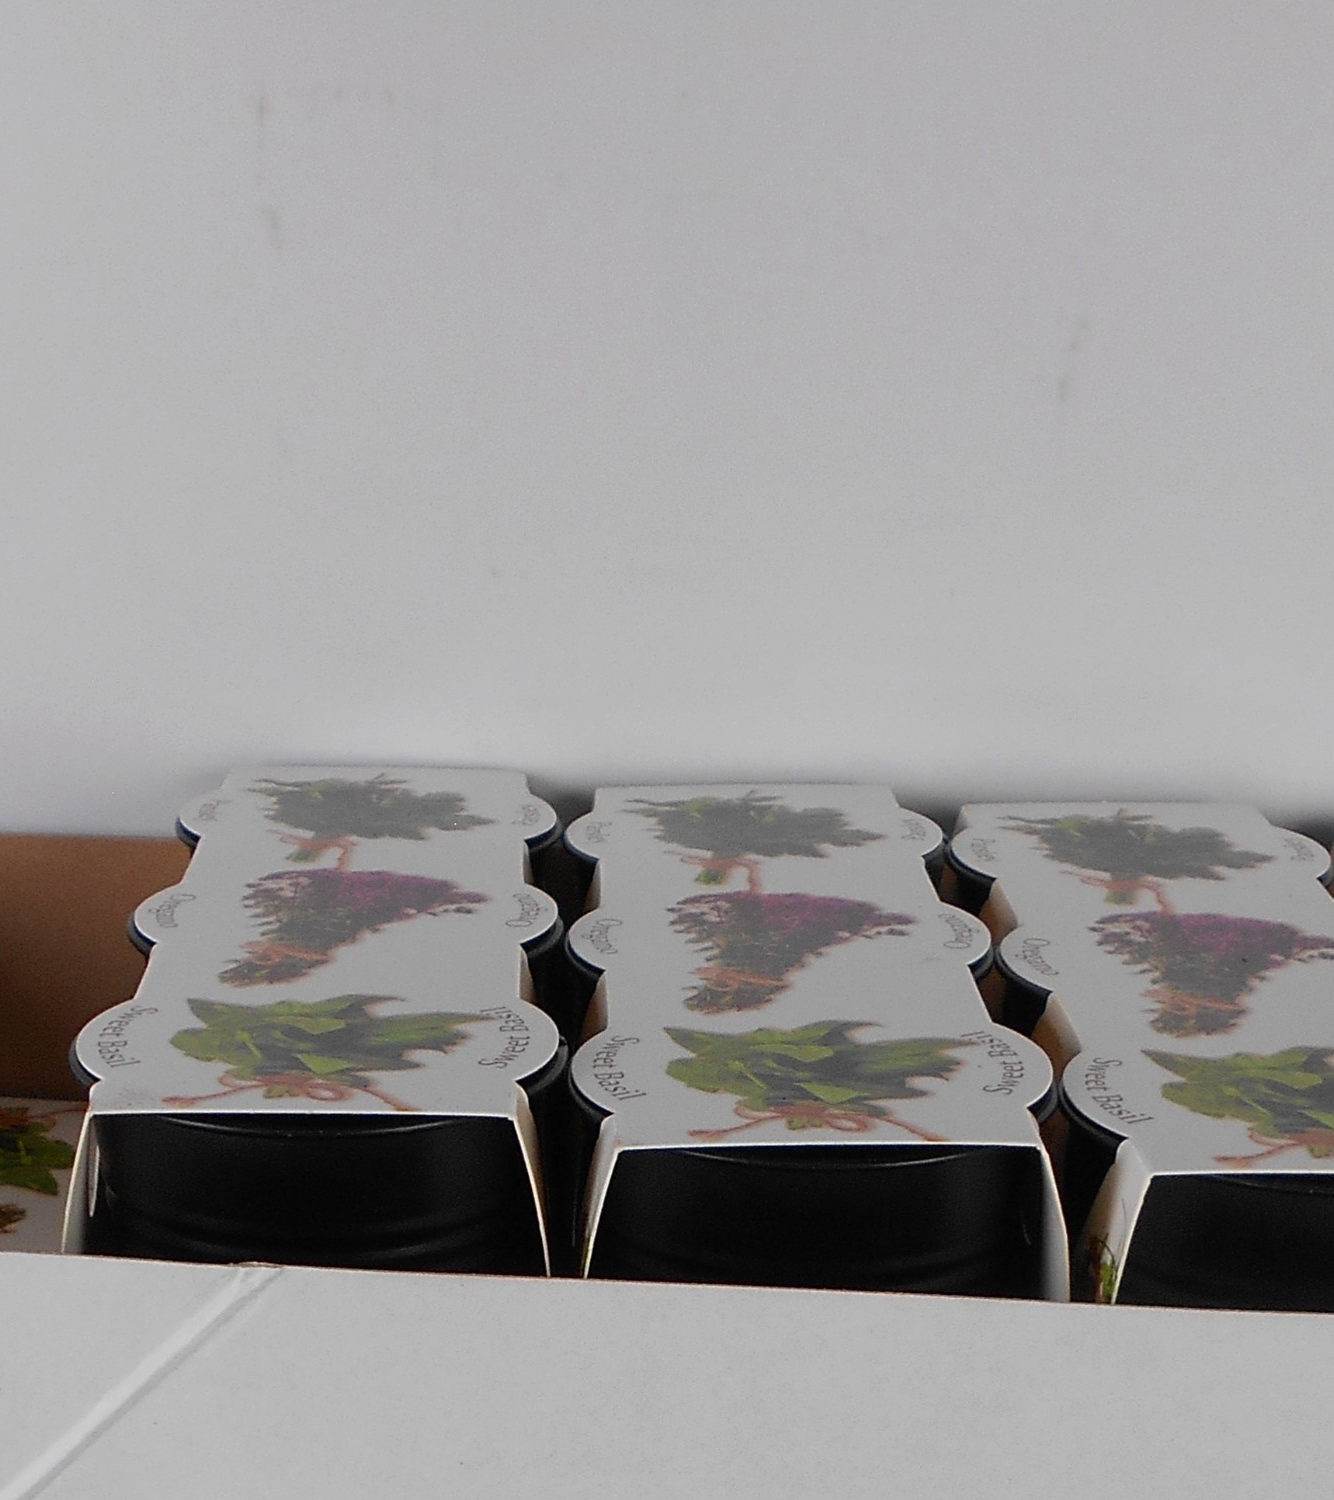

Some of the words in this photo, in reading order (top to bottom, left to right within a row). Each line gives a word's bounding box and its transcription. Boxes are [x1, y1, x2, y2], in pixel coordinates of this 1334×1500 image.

[480, 1005, 530, 1032] Basil
[478, 1033, 531, 1070] Sweet
[592, 1035, 640, 1069] Sweet
[960, 1029, 1020, 1060] Basil
[594, 1071, 647, 1101] Basil
[982, 1060, 1025, 1095] Sweet
[1084, 1056, 1123, 1092] Sweet
[1092, 1091, 1154, 1126] Basil
